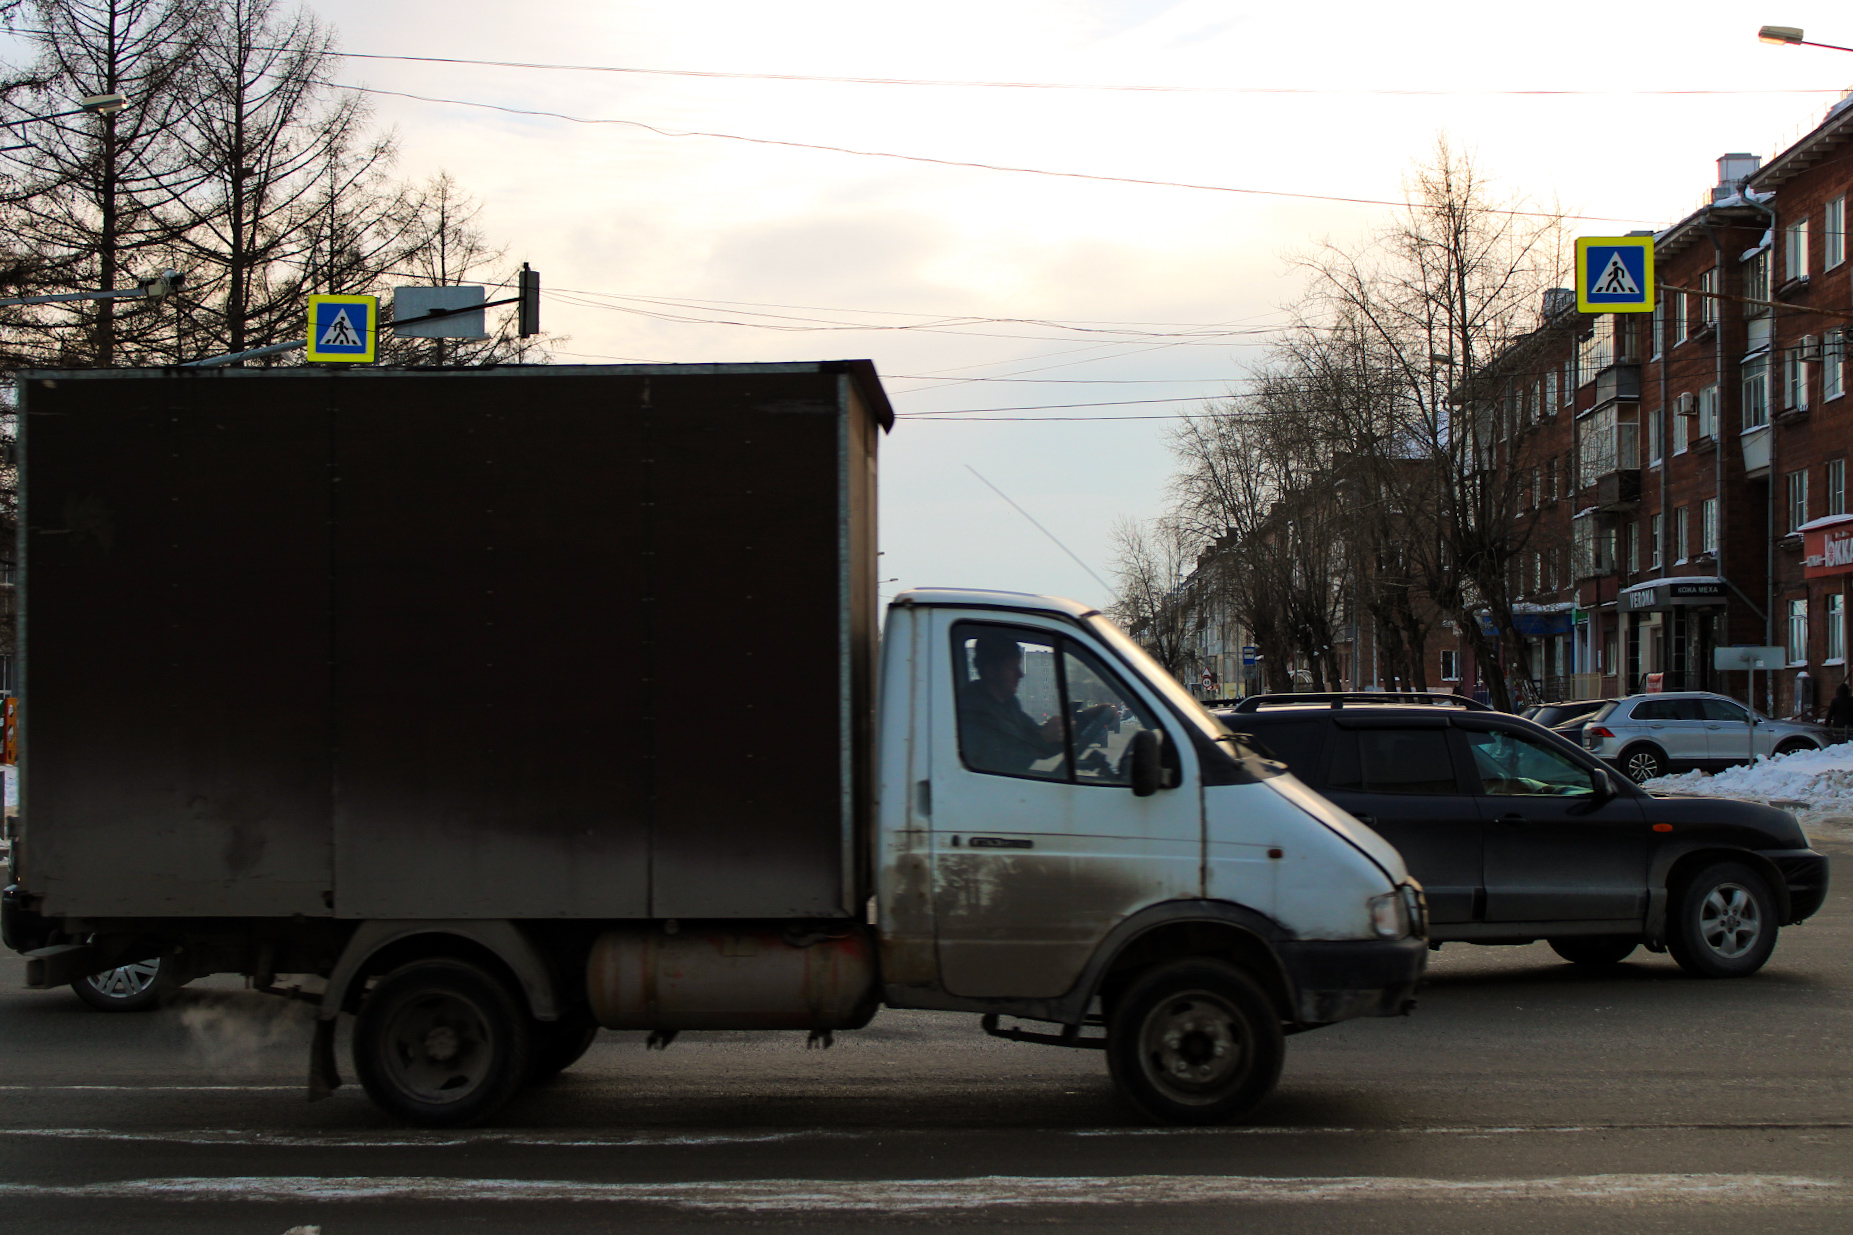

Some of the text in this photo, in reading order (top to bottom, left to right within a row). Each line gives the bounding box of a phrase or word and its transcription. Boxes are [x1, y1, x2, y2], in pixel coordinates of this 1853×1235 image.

[1677, 586, 1718, 594] КОЖА МЕХА
[1629, 589, 1655, 608] VERONA
